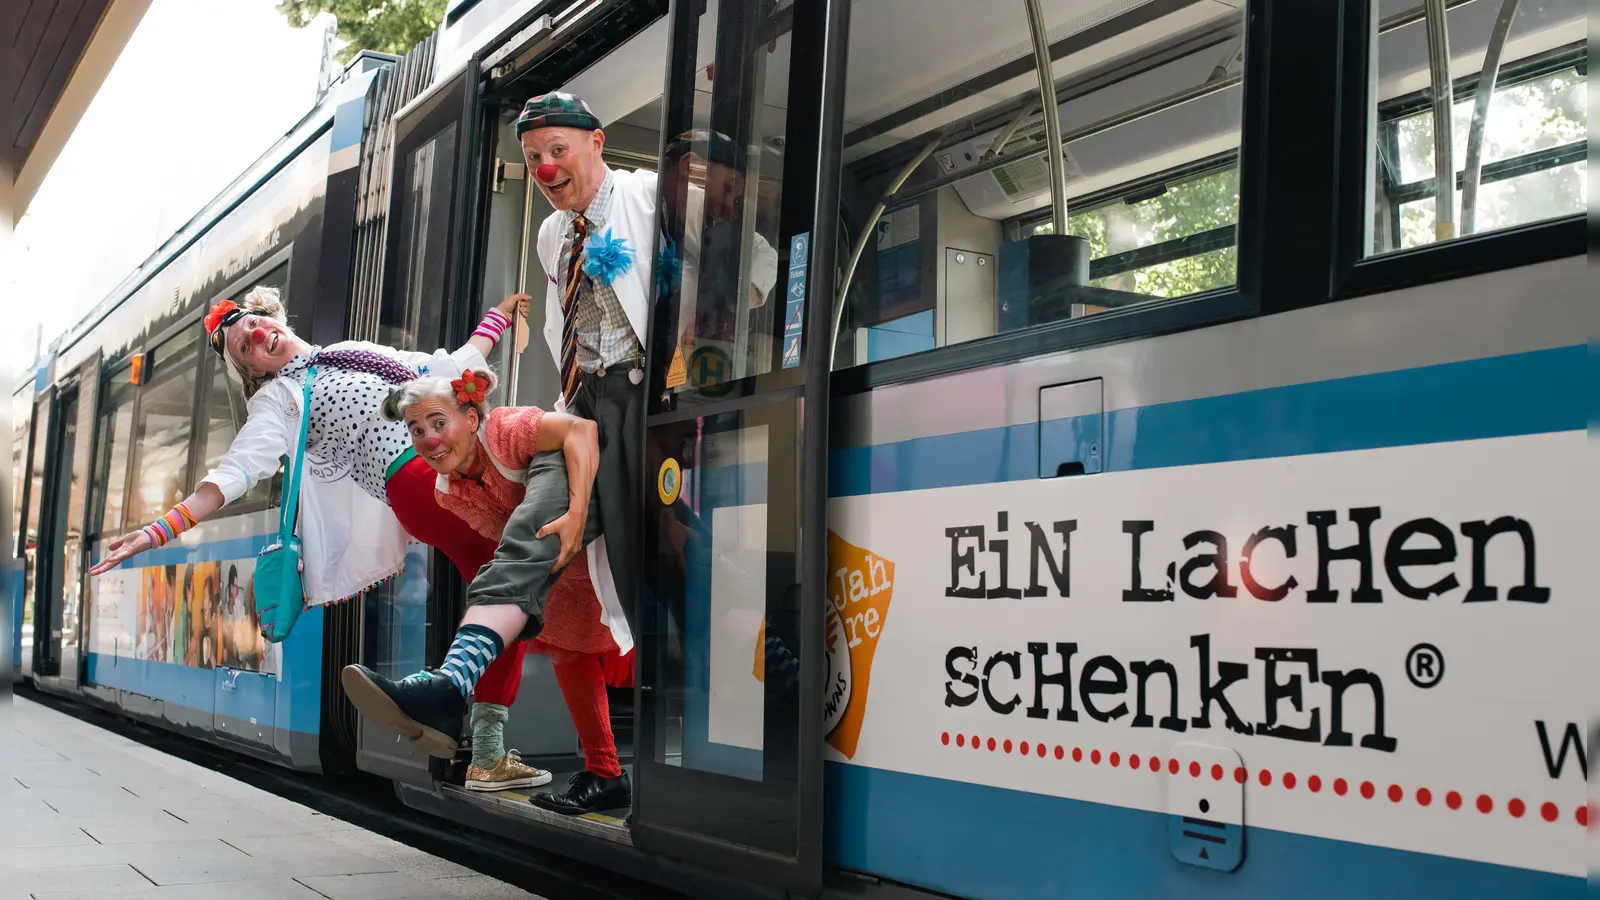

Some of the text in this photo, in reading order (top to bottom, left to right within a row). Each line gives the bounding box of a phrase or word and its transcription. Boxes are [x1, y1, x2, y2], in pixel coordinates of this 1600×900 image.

[700, 356, 724, 385] H
[834, 554, 892, 611] Jah
[845, 607, 881, 649] re
[823, 671, 847, 722] WNS
